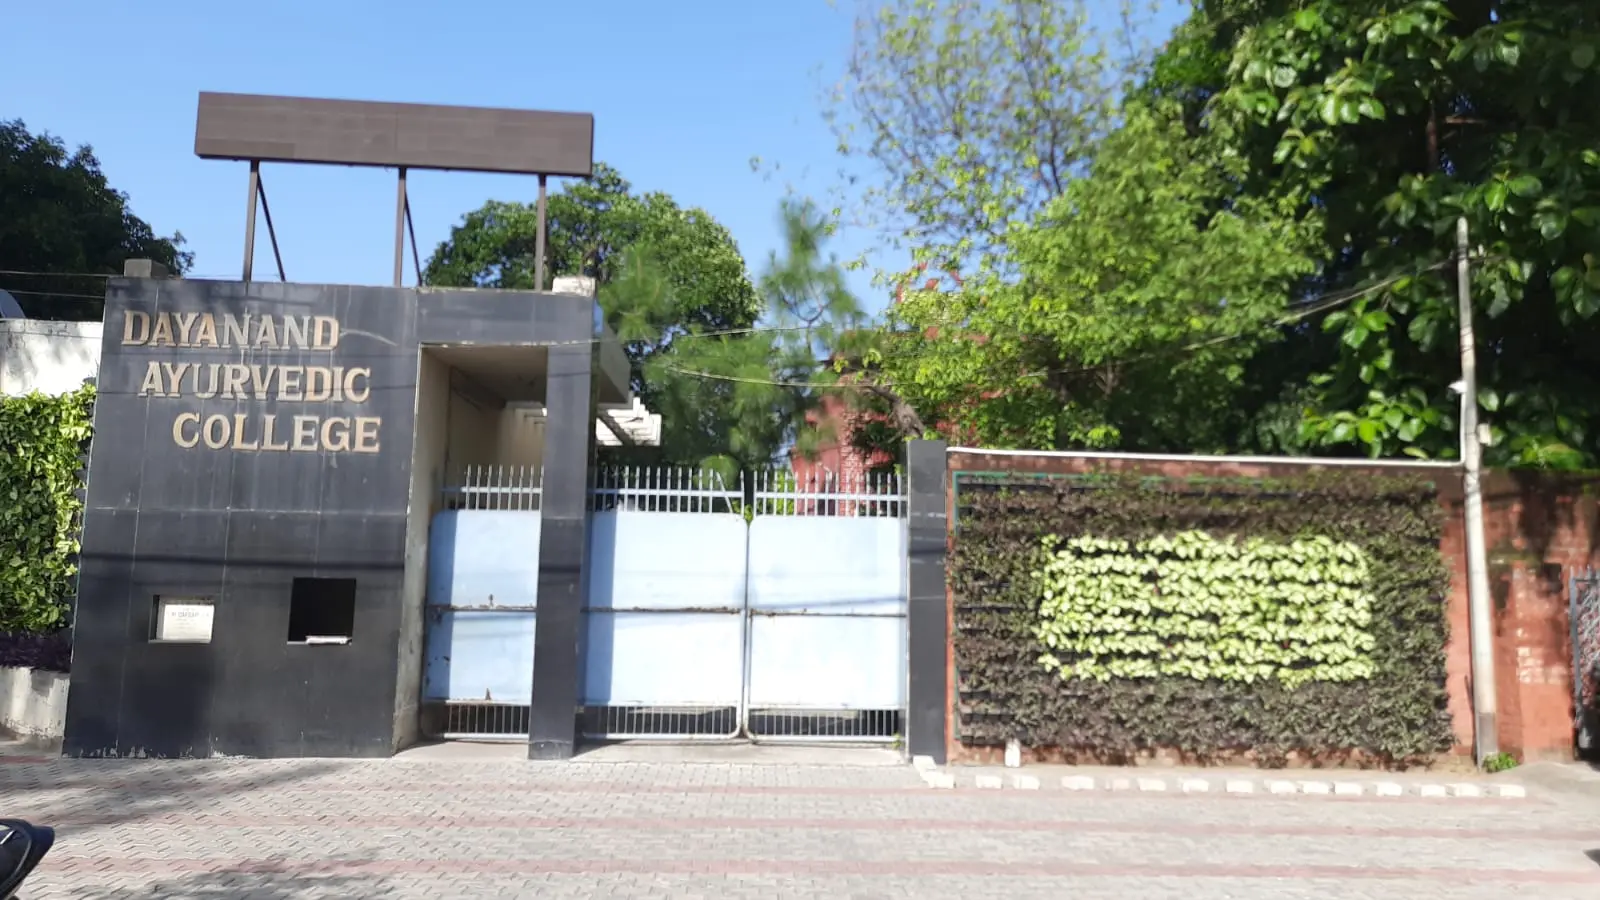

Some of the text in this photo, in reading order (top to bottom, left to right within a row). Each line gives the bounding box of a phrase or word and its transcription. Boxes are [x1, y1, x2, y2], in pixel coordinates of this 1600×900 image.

[121, 310, 340, 350] DAYANAND
[137, 361, 371, 404] AYURVEDIC
[173, 412, 382, 452] COLLEGE
